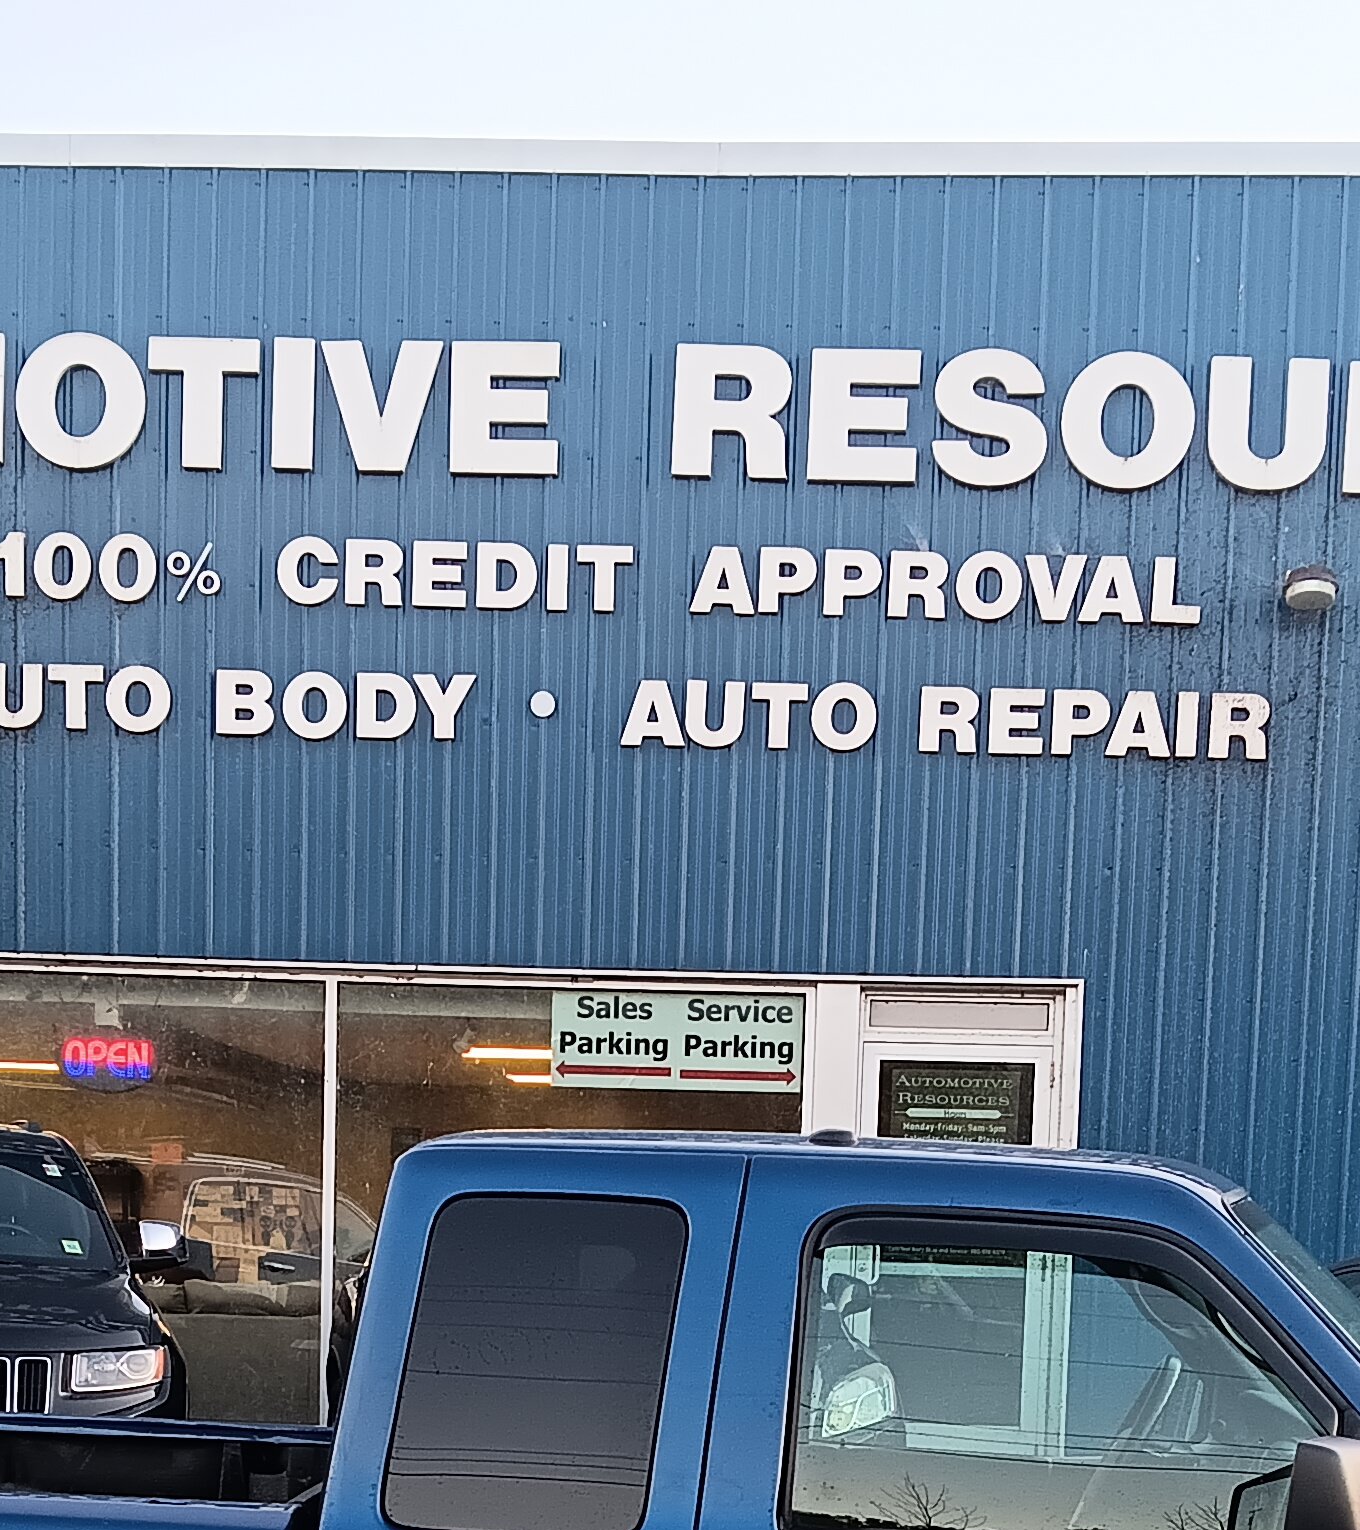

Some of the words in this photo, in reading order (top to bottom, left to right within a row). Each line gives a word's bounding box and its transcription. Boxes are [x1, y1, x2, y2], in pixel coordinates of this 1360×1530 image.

[277, 535, 634, 612] CREDIT
[689, 546, 1202, 624] APPROVAL
[215, 668, 477, 739] BODY
[620, 679, 878, 751] AUTO
[918, 685, 1271, 760] REPAIR
[576, 996, 653, 1020] Sales
[686, 999, 794, 1023] Service
[64, 1039, 151, 1079] OPEN
[559, 1031, 669, 1062] Parking
[684, 1034, 795, 1065] Parking
